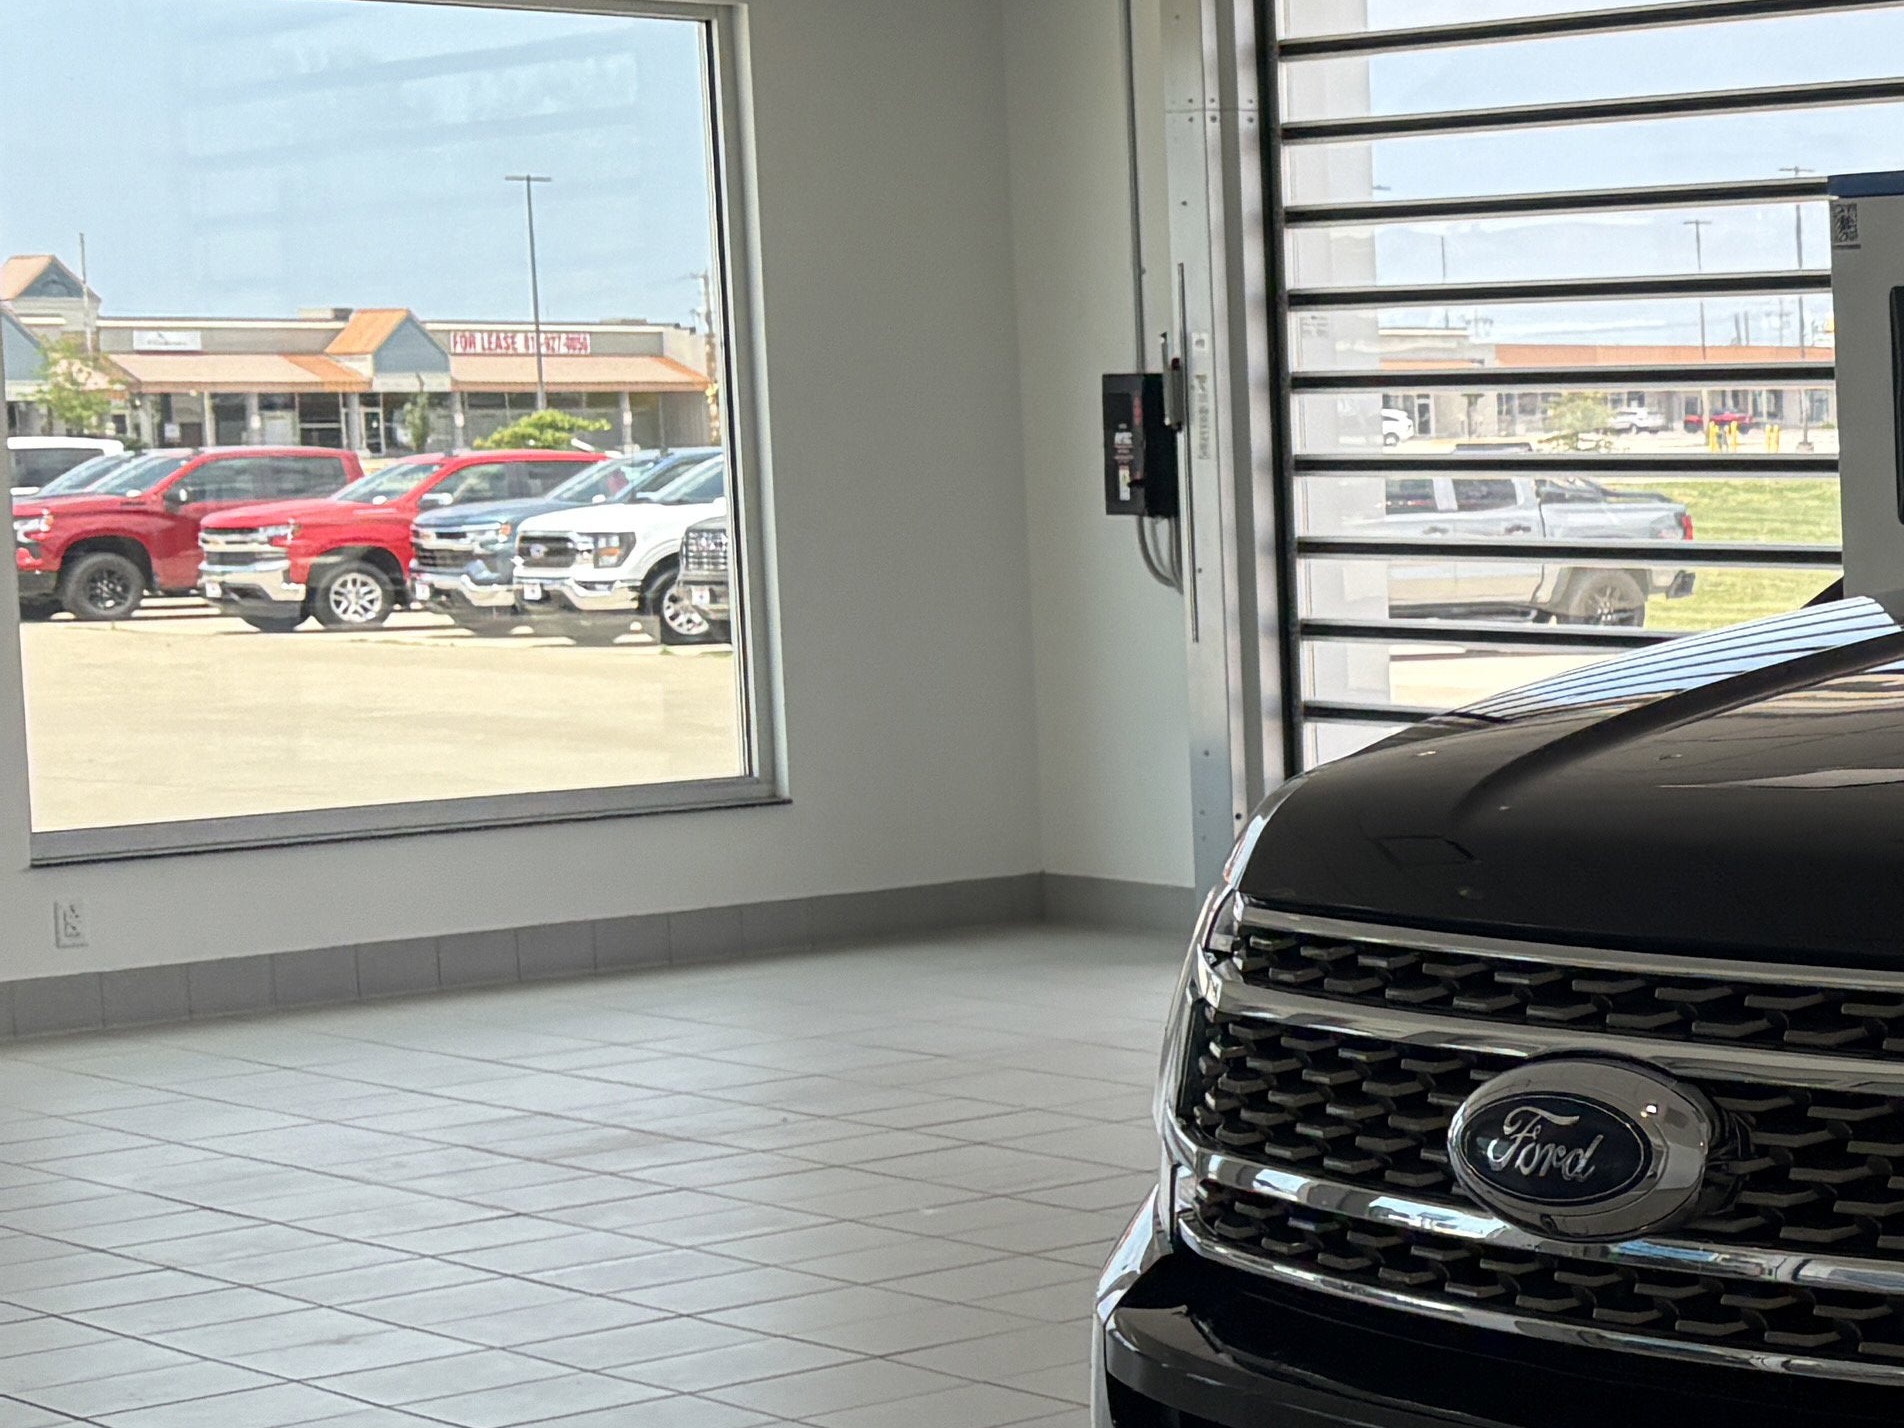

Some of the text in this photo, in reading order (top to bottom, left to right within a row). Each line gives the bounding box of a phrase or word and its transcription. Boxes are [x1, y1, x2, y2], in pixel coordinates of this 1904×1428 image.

[453, 332, 476, 353] FOR
[481, 332, 518, 353] LEASE
[1486, 1106, 1604, 1184] Ford
